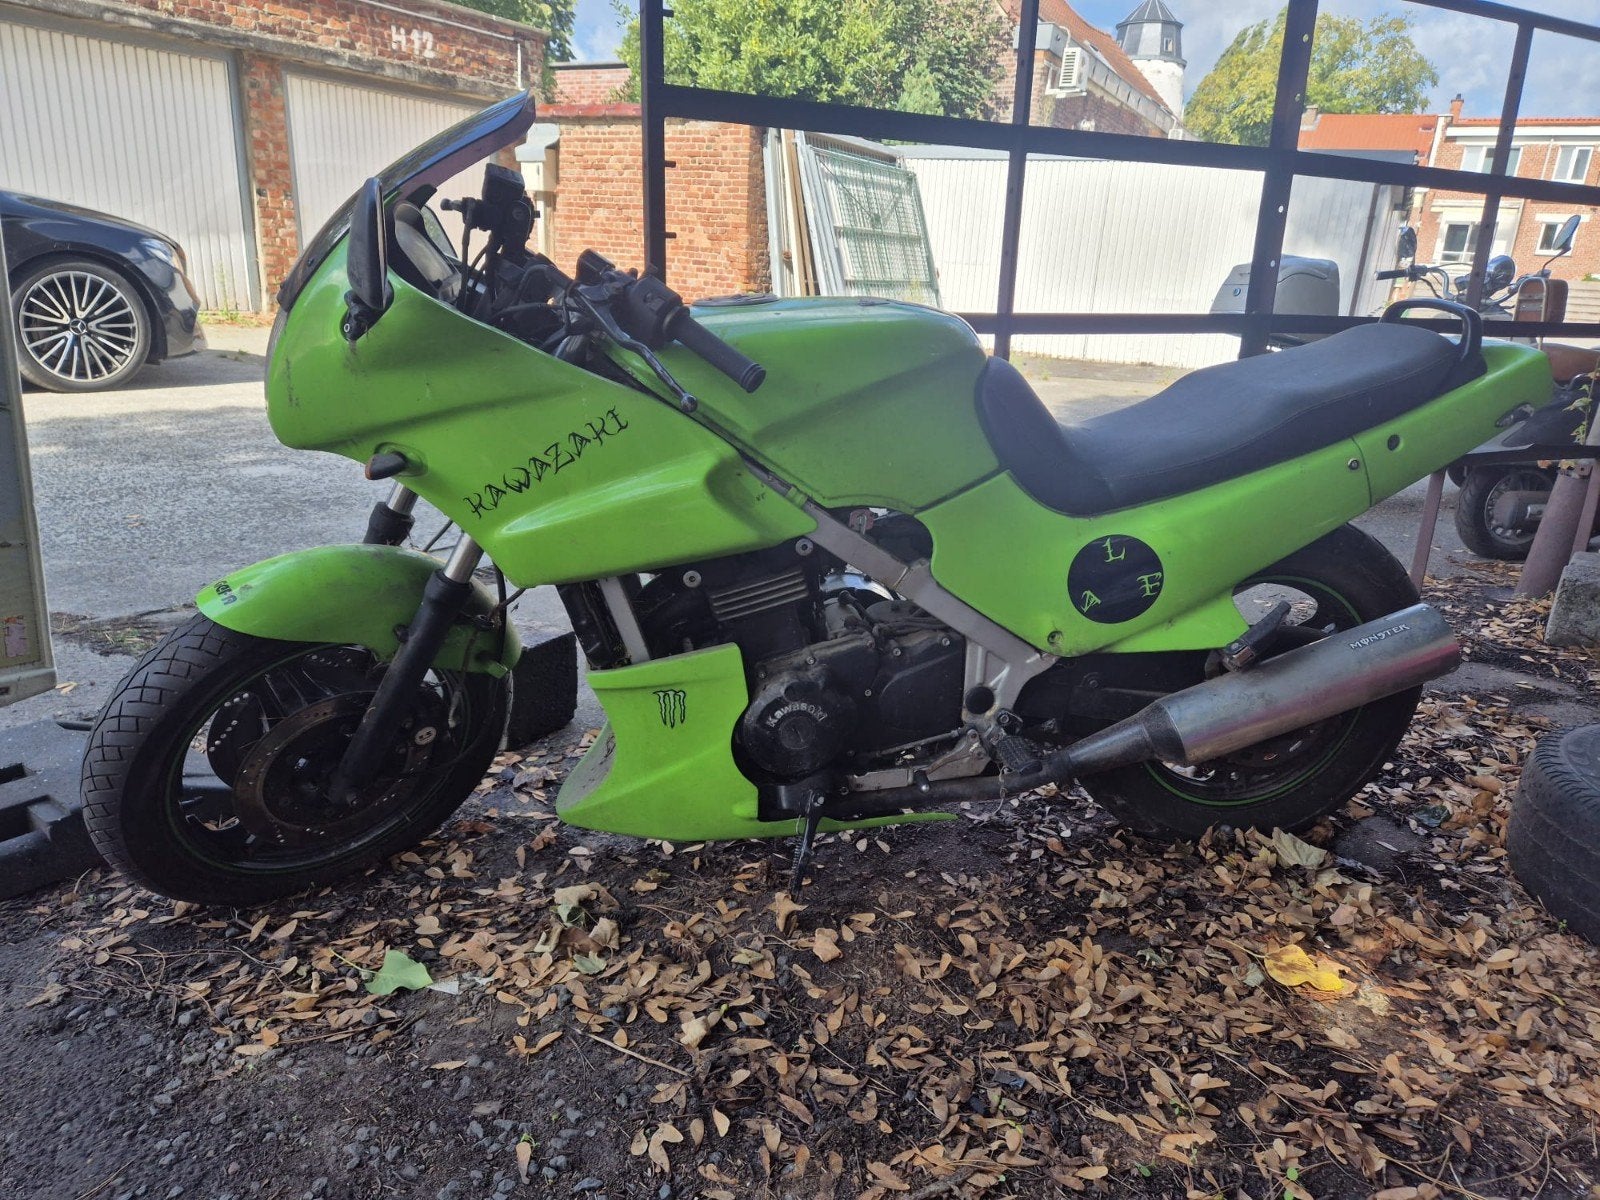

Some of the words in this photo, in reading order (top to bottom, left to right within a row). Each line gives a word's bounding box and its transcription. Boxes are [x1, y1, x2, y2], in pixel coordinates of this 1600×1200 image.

[463, 405, 629, 520] KAWAZAKI
[1102, 537, 1126, 563] L
[1081, 590, 1102, 613] A
[766, 702, 828, 728] Kawasaki
